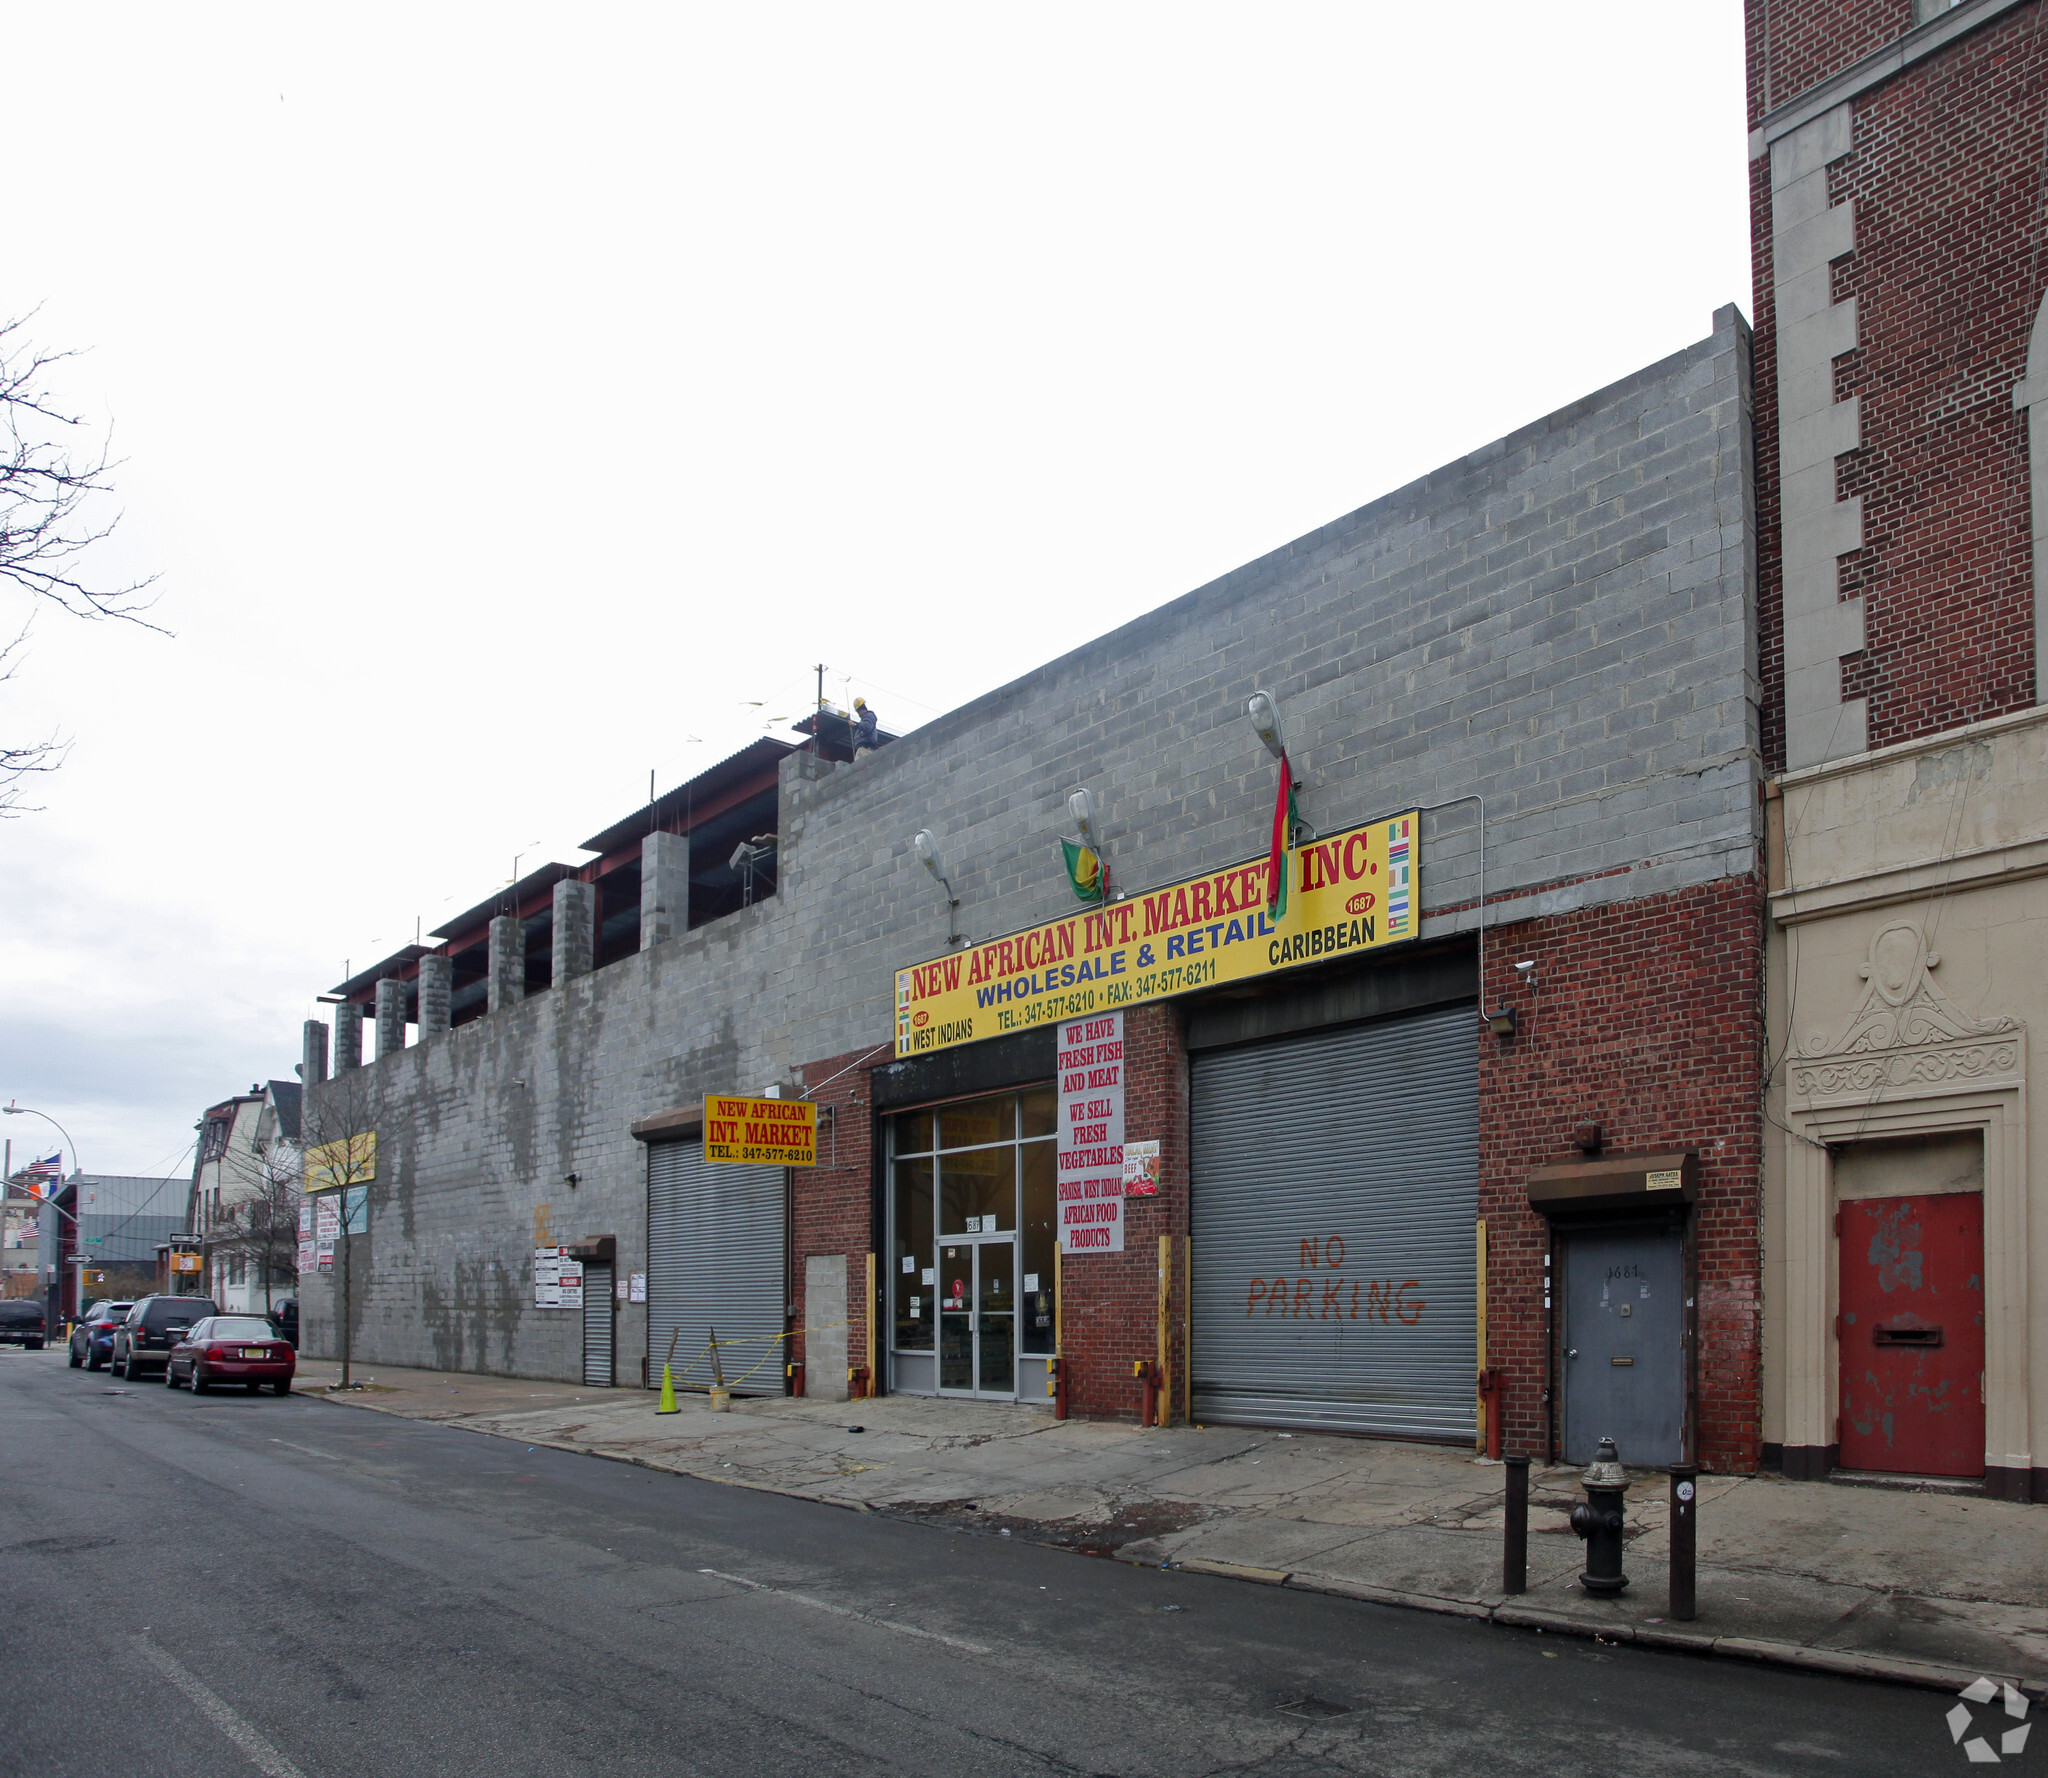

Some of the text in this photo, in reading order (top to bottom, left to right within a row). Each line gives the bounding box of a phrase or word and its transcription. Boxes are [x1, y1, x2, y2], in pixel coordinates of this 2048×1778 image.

[912, 832, 1377, 1001] NEW AFRICAN INT. MARKE INC.
[1347, 894, 1373, 914] 1687
[1269, 915, 1375, 965] CARIBBEAN
[976, 911, 1275, 1009] WHOLESALE & RETAIL
[997, 958, 1215, 1030] TEL.: 347-577-6210 FAX: 347-577-6211
[913, 1012, 928, 1026] 1687
[1066, 1018, 1114, 1045] WE HAVE
[913, 1018, 973, 1050] WEST INDIANS
[1058, 1041, 1122, 1070] FRESH FISH
[1063, 1066, 1119, 1093] AND MEAT
[717, 1101, 806, 1121] NEW AFRICAN
[1069, 1099, 1112, 1122] WE SELL
[709, 1120, 812, 1147] INT. MARKET
[1073, 1123, 1107, 1145] FRESH
[709, 1145, 812, 1161] TEL.: 347-577-6210
[1059, 1145, 1123, 1170] VEGETABLES
[1124, 1163, 1137, 1174] BEEF
[1058, 1177, 1122, 1201] SPANISH, WEST INDIAN
[1064, 1203, 1117, 1224] AFRICAN FOOD
[1070, 1227, 1110, 1248] PRODUCTS
[1301, 1235, 1345, 1268] NO
[1247, 1277, 1426, 1324] PARKING
